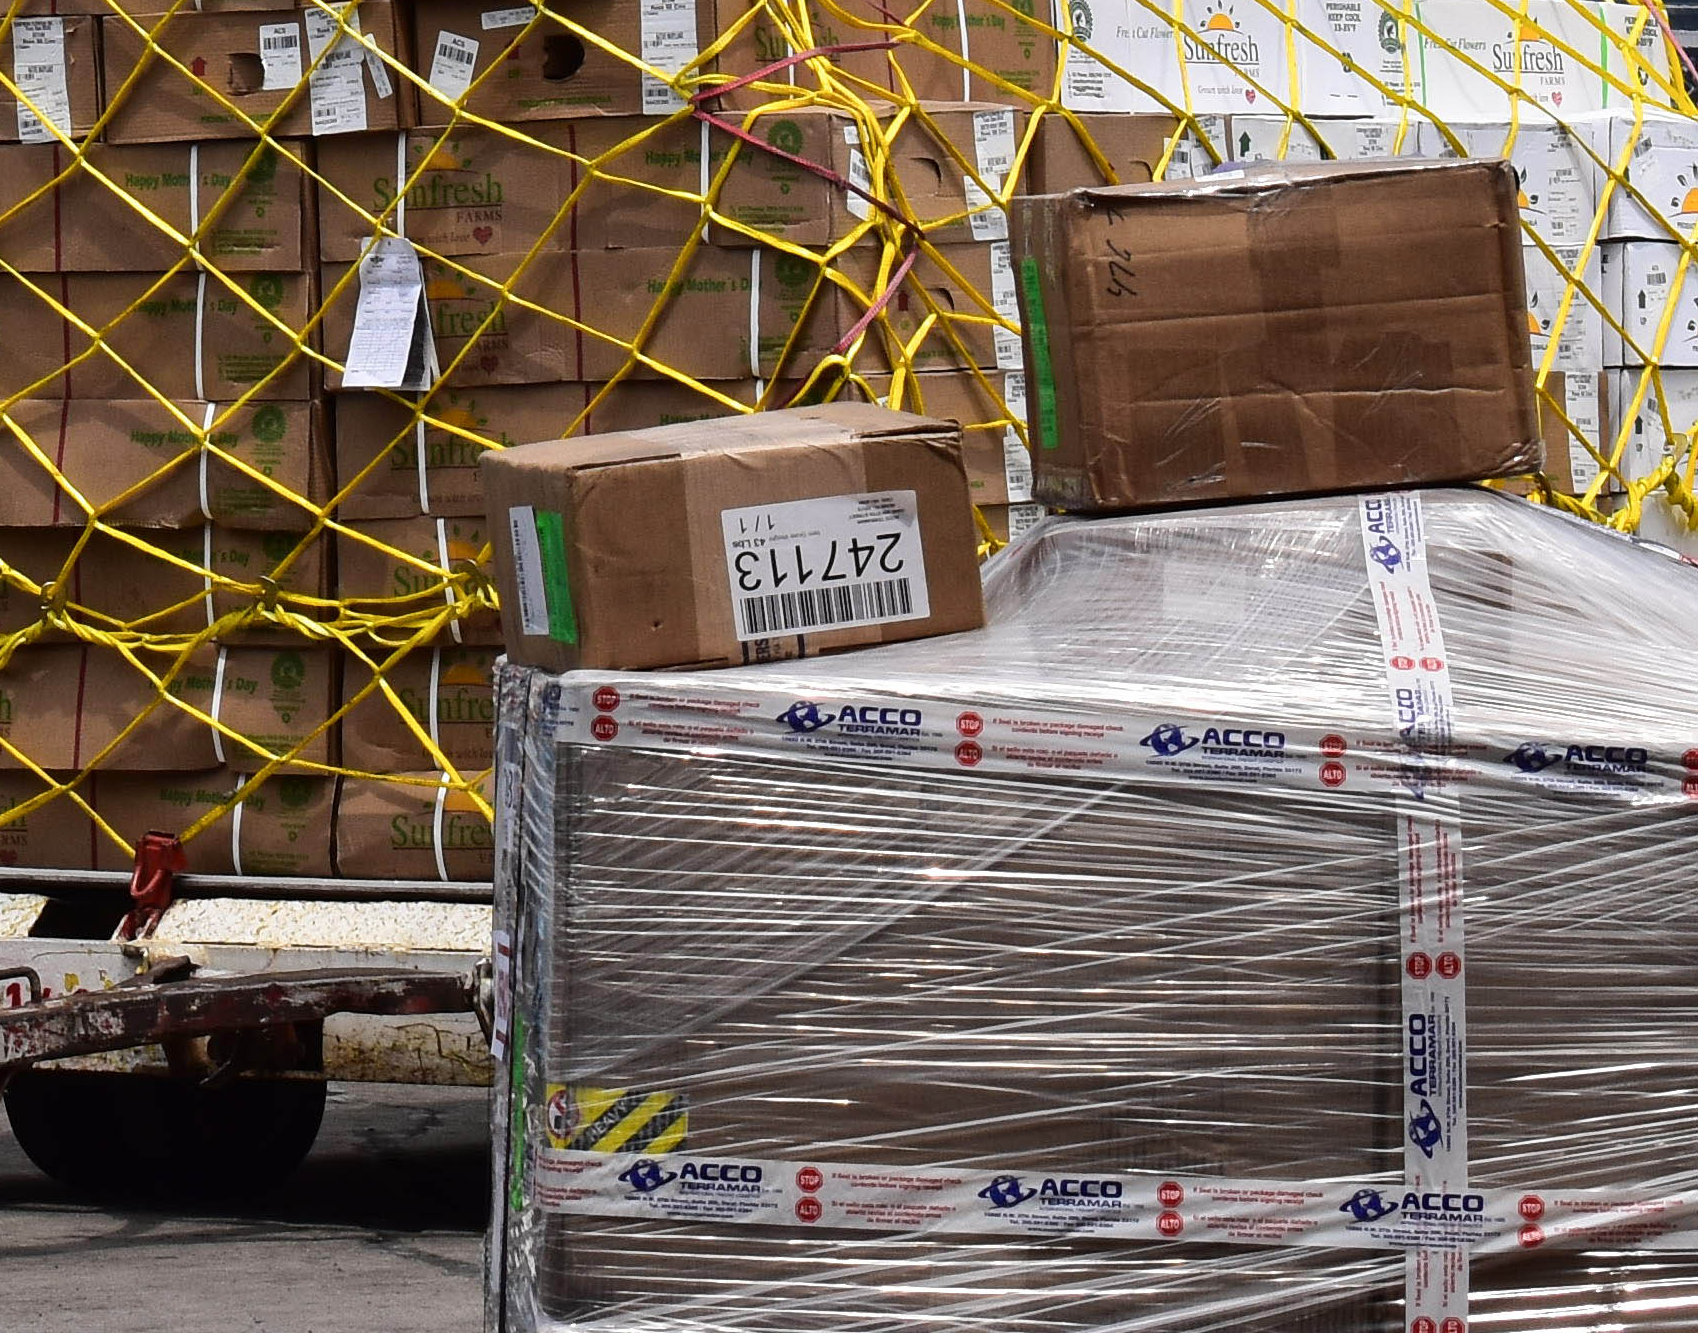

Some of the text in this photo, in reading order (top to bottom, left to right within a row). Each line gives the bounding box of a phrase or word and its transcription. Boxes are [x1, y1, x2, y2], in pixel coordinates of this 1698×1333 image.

[1326, 3, 1361, 12] PERISHABLE
[645, 150, 681, 166] Happy
[125, 173, 158, 190] Happy
[212, 174, 232, 189] Day
[456, 211, 502, 222] FARMS
[732, 539, 751, 548] Lbs
[754, 537, 765, 547] 43
[734, 532, 904, 591] 247113
[236, 677, 258, 693] Day
[838, 705, 922, 726] ACCO
[594, 722, 616, 734] ALTO
[838, 723, 921, 736] TERRAMAR
[959, 718, 980, 729] STOP
[1203, 728, 1285, 748] ACCO
[958, 748, 980, 759] ALTO
[1203, 747, 1285, 759] TERRAMAR
[1565, 745, 1648, 764] ACCO
[1323, 769, 1343, 780] ALTO
[1415, 955, 1424, 974] STOP
[1444, 955, 1453, 975] ALTO
[1409, 1013, 1427, 1097] ACCO
[1428, 1014, 1437, 1097] TERRAMAR
[679, 1164, 762, 1183] ACCO
[798, 1175, 820, 1185] STOP
[679, 1182, 761, 1193] TERRAMAR
[1040, 1179, 1123, 1197] ACCO
[1161, 1189, 1181, 1199] STOP
[1040, 1197, 1122, 1209] TERRAMAR
[1401, 1193, 1484, 1212] ACCO
[1522, 1203, 1541, 1214] STOP
[1401, 1211, 1483, 1223] TERRAMAR
[1160, 1219, 1180, 1229] ALTO
